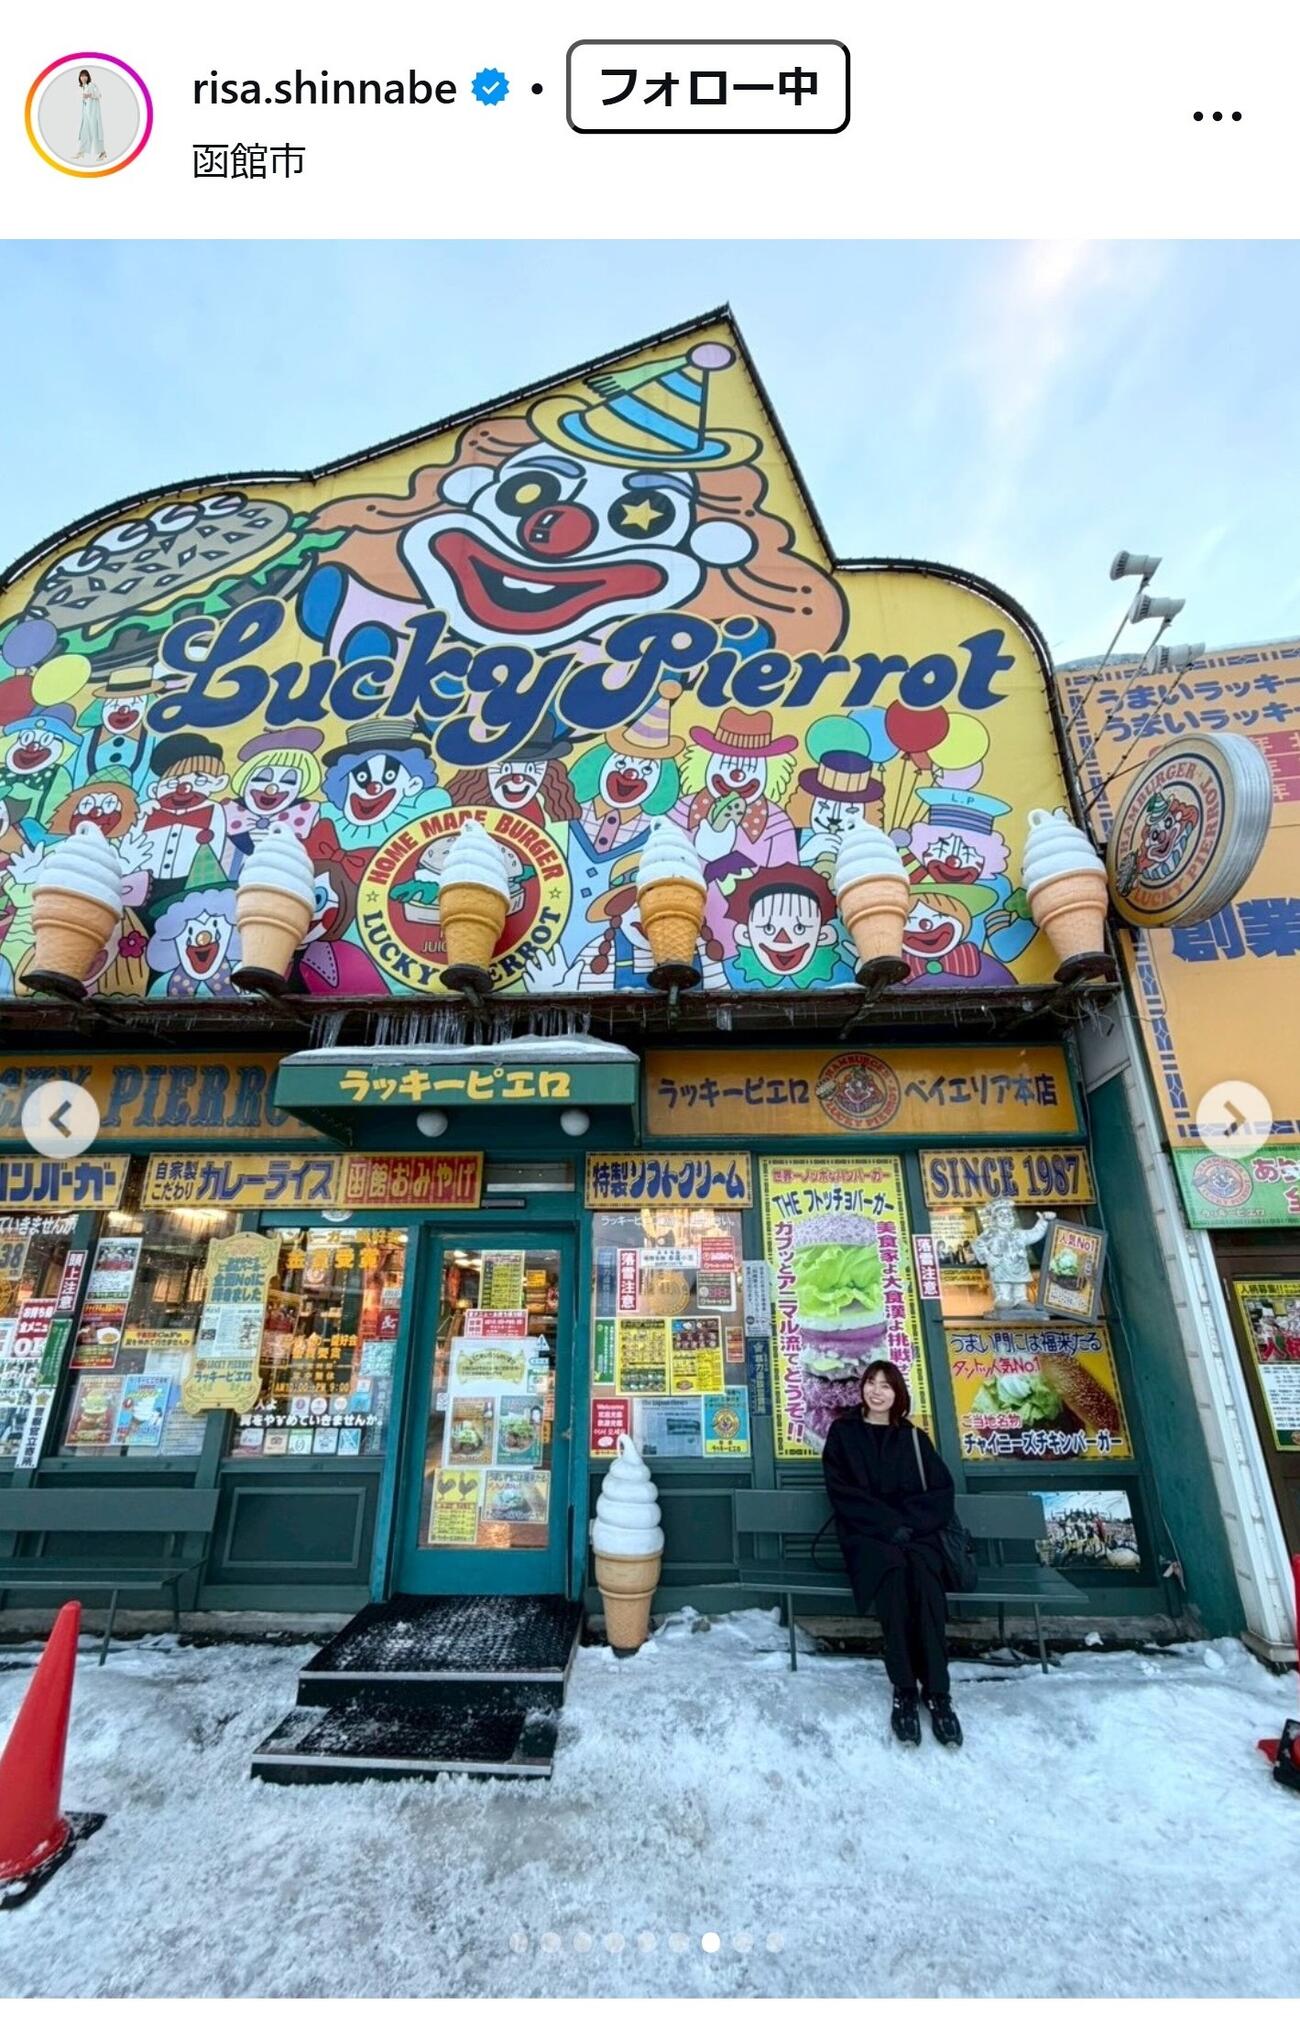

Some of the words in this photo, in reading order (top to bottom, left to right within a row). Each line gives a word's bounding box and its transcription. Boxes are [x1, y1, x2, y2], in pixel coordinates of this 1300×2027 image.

[148, 600, 574, 767] Lucky
[556, 611, 1016, 733] Pierrot
[367, 830, 419, 885] HOME
[494, 814, 565, 882] BURGER
[363, 909, 440, 986] LUCKY
[101, 1064, 310, 1128] PIERRO
[339, 1068, 572, 1101] ラッキーピエロ
[658, 1076, 810, 1108] ラッキーピエロ
[904, 1075, 1059, 1107] ベイエリア本店
[151, 1182, 193, 1201] こだわり
[154, 1162, 197, 1180] 自家製
[198, 1159, 336, 1201] カレーライス
[346, 1159, 477, 1199] 函館おみやげ
[591, 1160, 746, 1201] 特製ソフトクリーム
[931, 1155, 1020, 1199] SINCE
[1027, 1153, 1082, 1197] 1987
[772, 1190, 802, 1219] THE
[58, 1252, 85, 1311] 頭上注意
[620, 1251, 637, 1310] 落雪注意
[916, 1238, 939, 1297] 落雪注意
